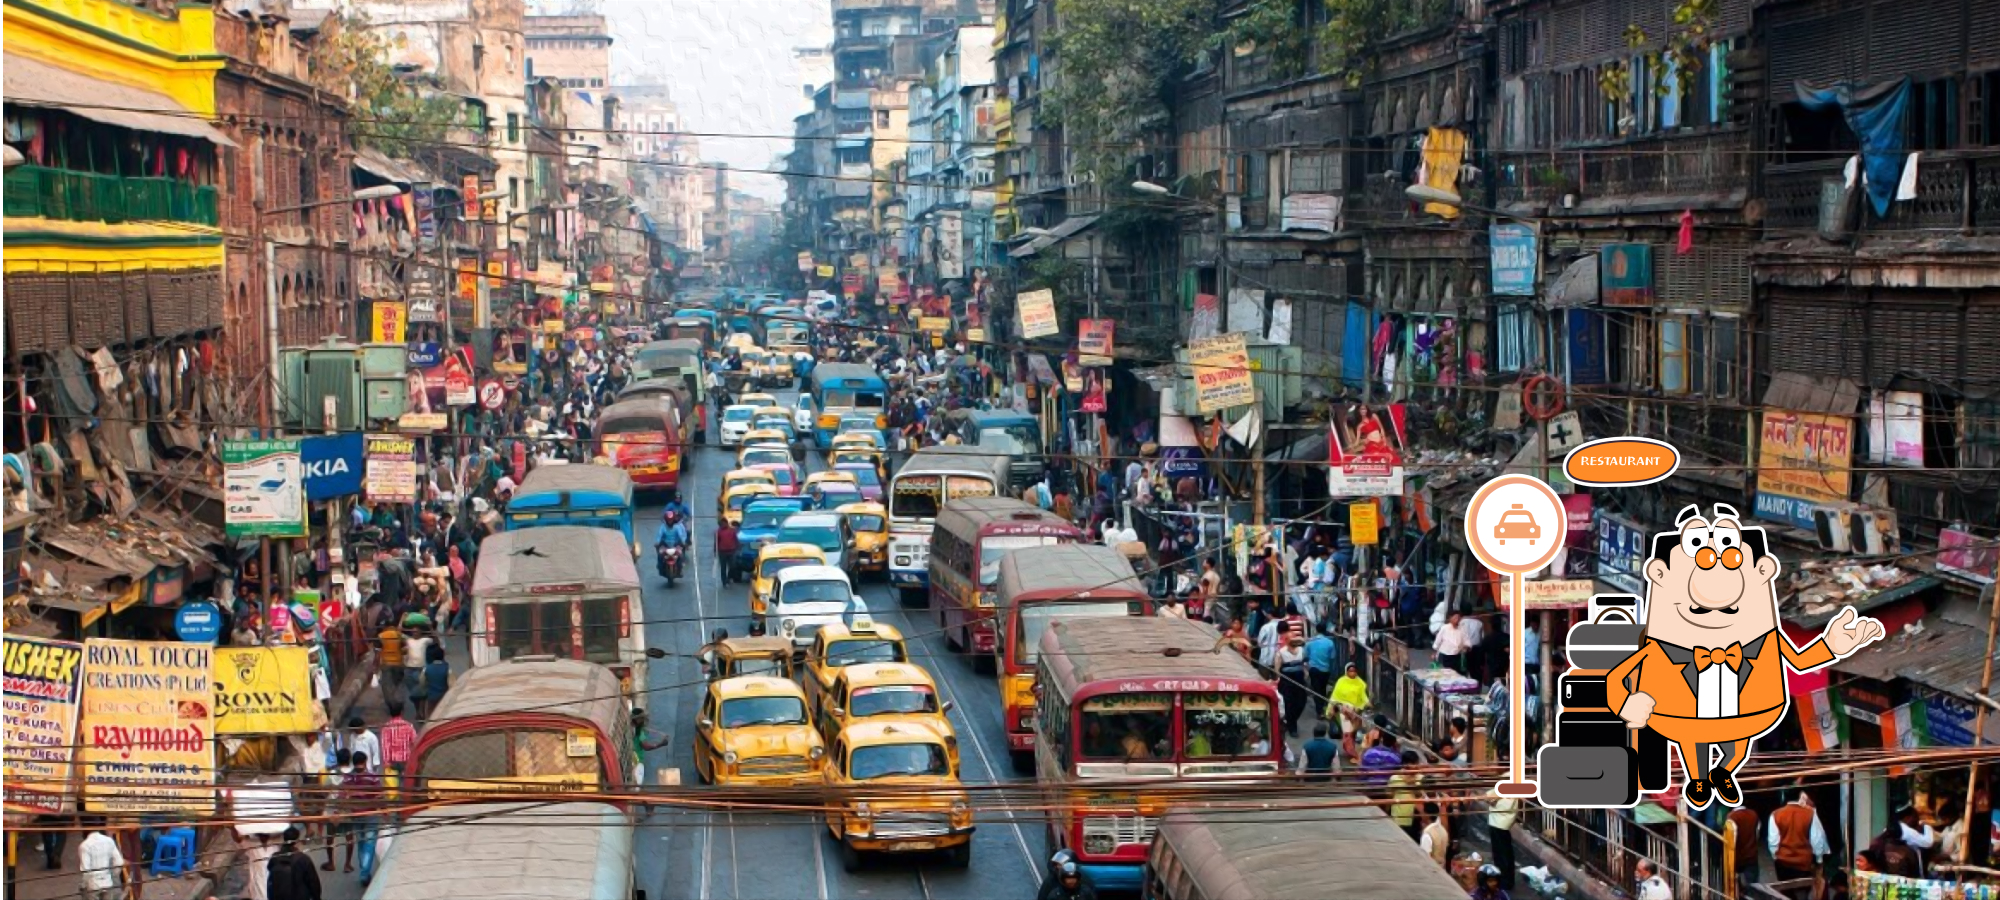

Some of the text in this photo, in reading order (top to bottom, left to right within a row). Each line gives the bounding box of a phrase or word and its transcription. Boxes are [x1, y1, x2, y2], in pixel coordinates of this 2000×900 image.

[89, 645, 208, 668] ROYAL TOUCH
[87, 672, 161, 690] CREATIONS
[32, 704, 46, 714] OF
[92, 723, 204, 759] Raymond
